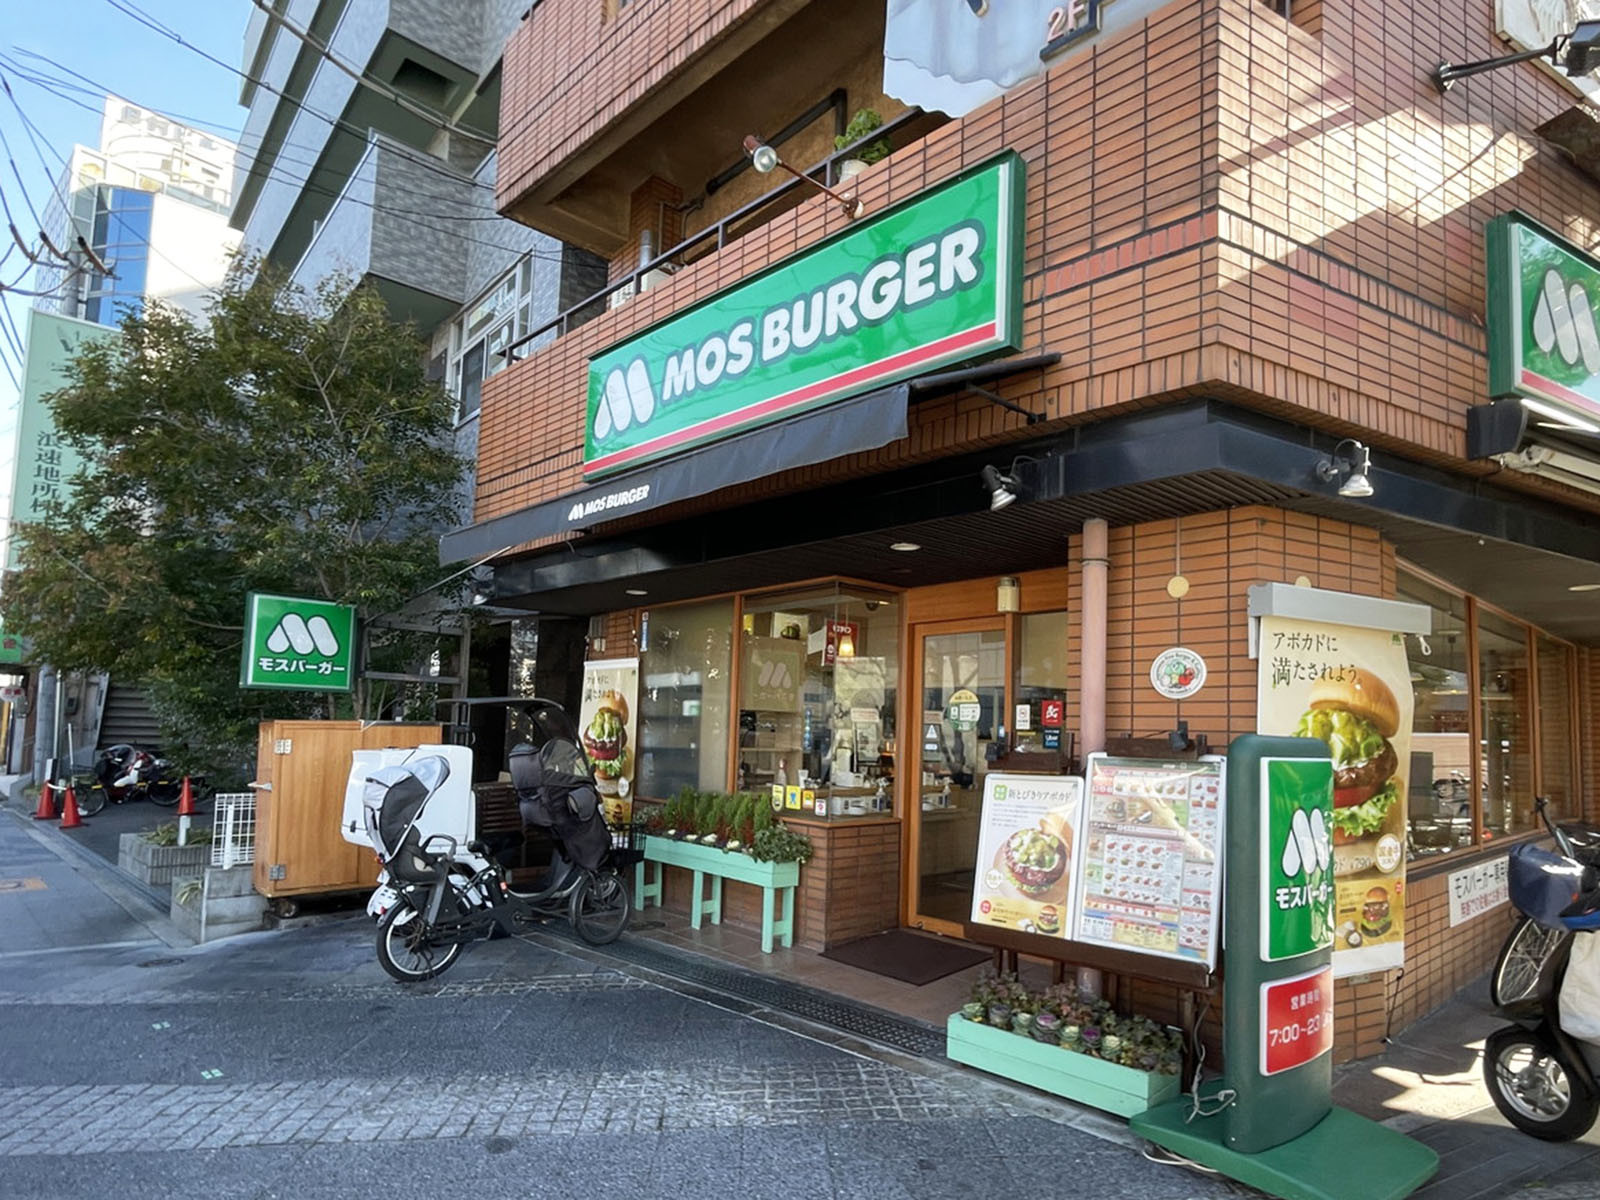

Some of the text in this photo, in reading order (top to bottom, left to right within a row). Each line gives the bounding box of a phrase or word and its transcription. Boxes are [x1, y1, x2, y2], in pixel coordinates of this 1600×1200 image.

[1047, 0, 1085, 42] 2F
[661, 226, 980, 402] MOS BURGER
[584, 484, 651, 516] MOS BURGER
[1273, 632, 1339, 652] アボカドに
[259, 657, 346, 675] モスバーガー
